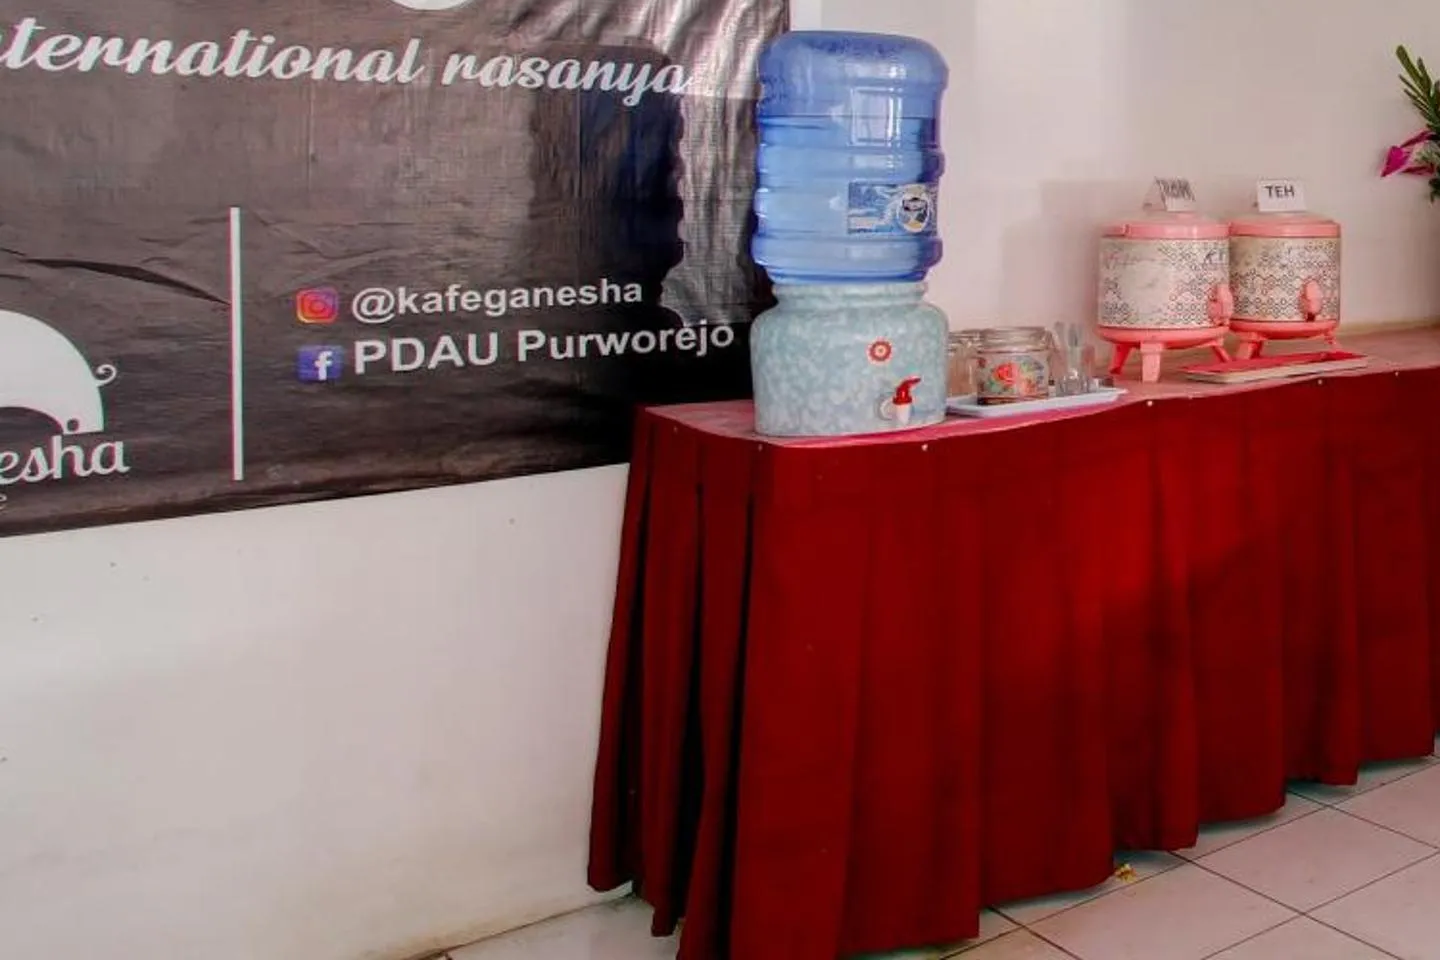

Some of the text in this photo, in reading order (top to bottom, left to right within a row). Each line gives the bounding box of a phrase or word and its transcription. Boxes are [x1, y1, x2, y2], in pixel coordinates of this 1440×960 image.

[0, 17, 696, 107] ternational rasanya
[1264, 185, 1295, 199] TEH
[352, 279, 643, 323] @kafeganesha
[354, 333, 498, 375] PDAU
[517, 319, 735, 363] Purworejo
